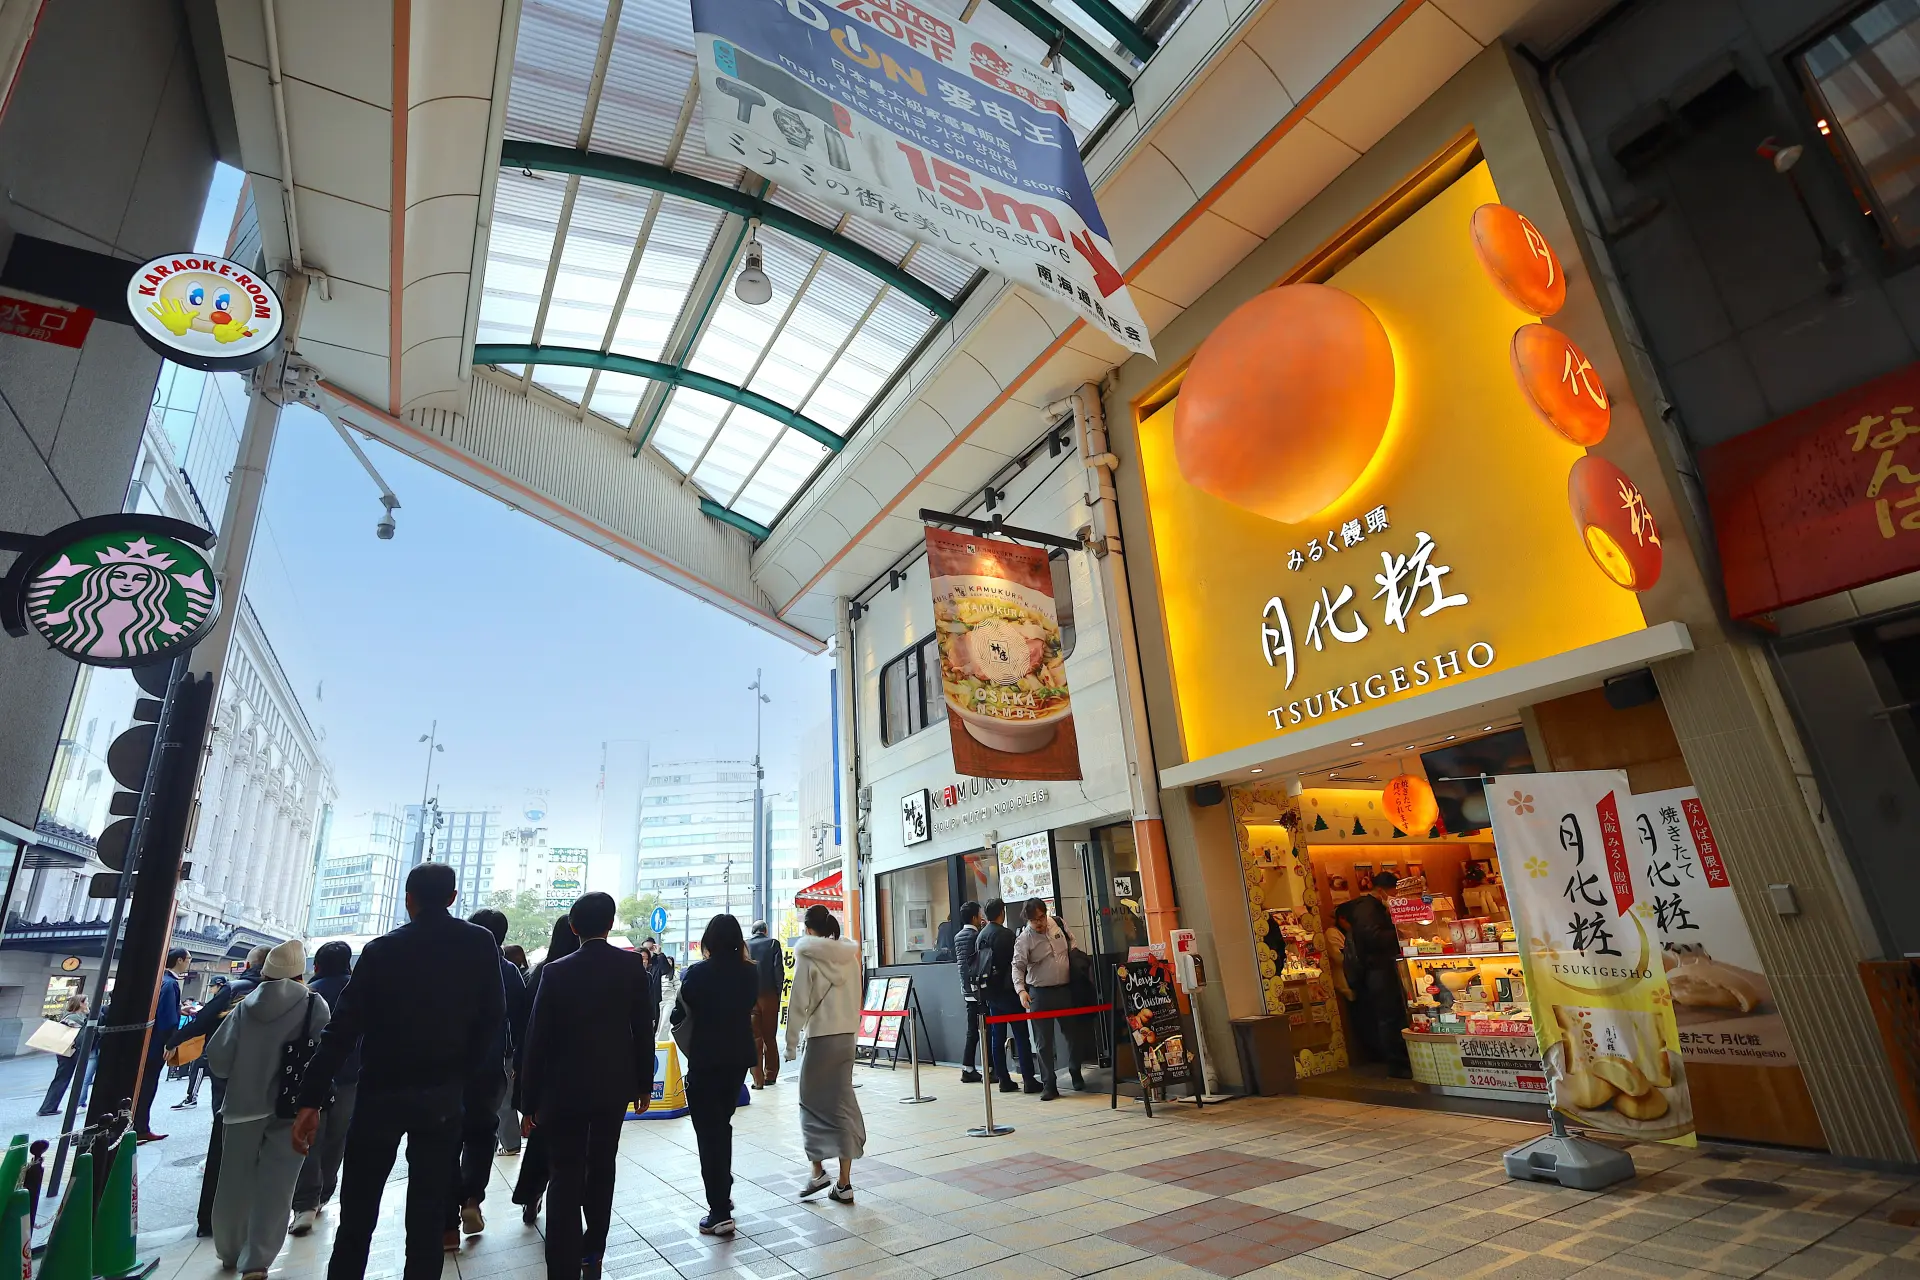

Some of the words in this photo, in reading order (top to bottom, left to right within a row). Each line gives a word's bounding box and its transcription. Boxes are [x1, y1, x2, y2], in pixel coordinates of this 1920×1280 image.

[776, 0, 928, 96] DION
[872, 0, 952, 42] Free
[778, 53, 837, 96] major
[842, 87, 940, 149] electronics
[944, 142, 1019, 184] Specialty
[1023, 177, 1072, 201] stores
[896, 141, 1065, 243] 15m
[916, 186, 1071, 264] Namba.store
[1035, 262, 1141, 342] 南海通商店会
[1287, 504, 1391, 572] みるく饅頭
[963, 602, 1025, 618] KAMUKURA
[1260, 531, 1470, 691] 月化粧
[975, 688, 1036, 706] OSAKA
[976, 703, 1036, 719] NAMBA
[1267, 641, 1495, 730] TSUKIGESHO
[933, 818, 957, 834] SOUP
[994, 789, 1045, 815] NOODLES
[1603, 810, 1617, 834] 大阪
[1658, 806, 1695, 879] 焼きたて
[1687, 801, 1724, 882] なんば店限定
[1559, 812, 1622, 957] 月化粧
[1607, 837, 1630, 895] みるく饅頭
[1635, 812, 1701, 933] 月化粧
[1552, 964, 1653, 979] TSUKIGESHO
[1460, 1039, 1540, 1058] 宅配便送料キャン
[1679, 1032, 1715, 1045] きたて
[1720, 1033, 1762, 1046] 月化粧
[1697, 1046, 1726, 1055] baked
[1729, 1048, 1787, 1058] Tsukigesho
